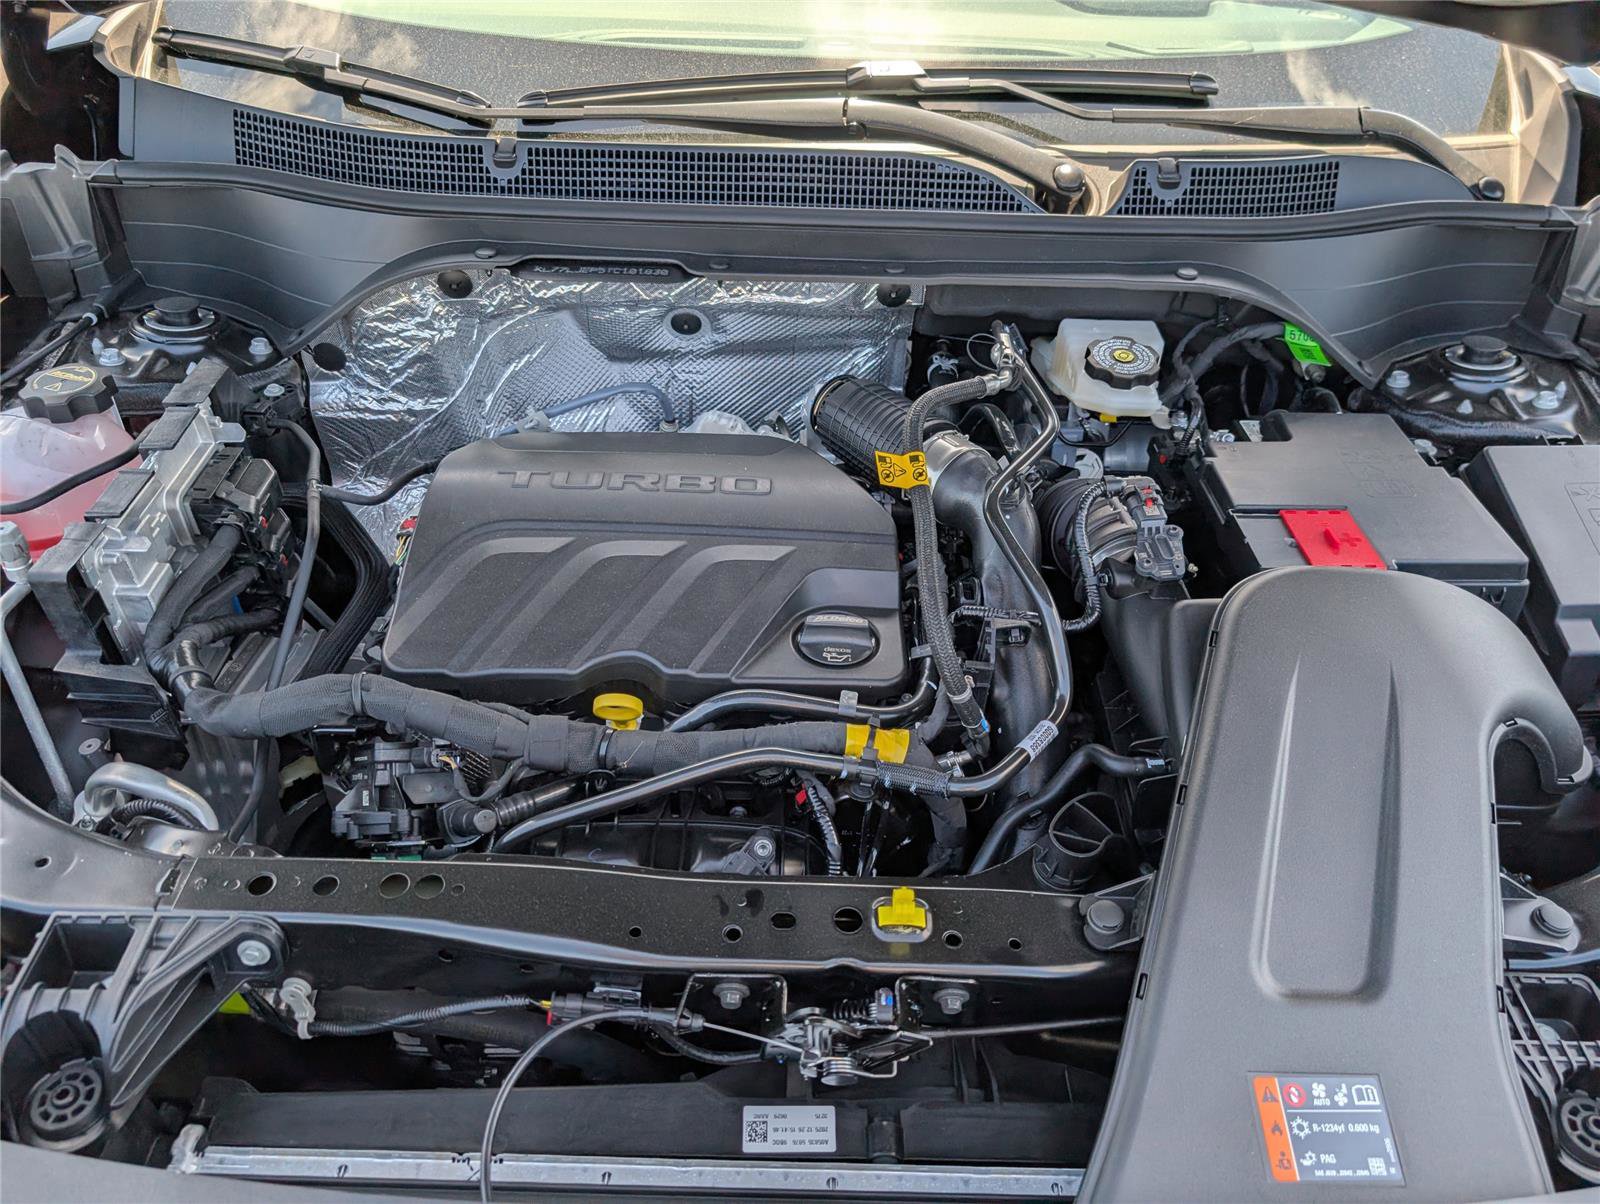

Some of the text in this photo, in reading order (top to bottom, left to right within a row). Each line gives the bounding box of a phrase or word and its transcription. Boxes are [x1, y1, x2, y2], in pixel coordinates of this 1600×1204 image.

[497, 470, 772, 495] TURBO
[1313, 1098, 1331, 1106] AUTO
[1312, 1123, 1345, 1134] R-1234yf
[1369, 1123, 1380, 1134] kg
[1319, 1154, 1336, 1164] PAG
